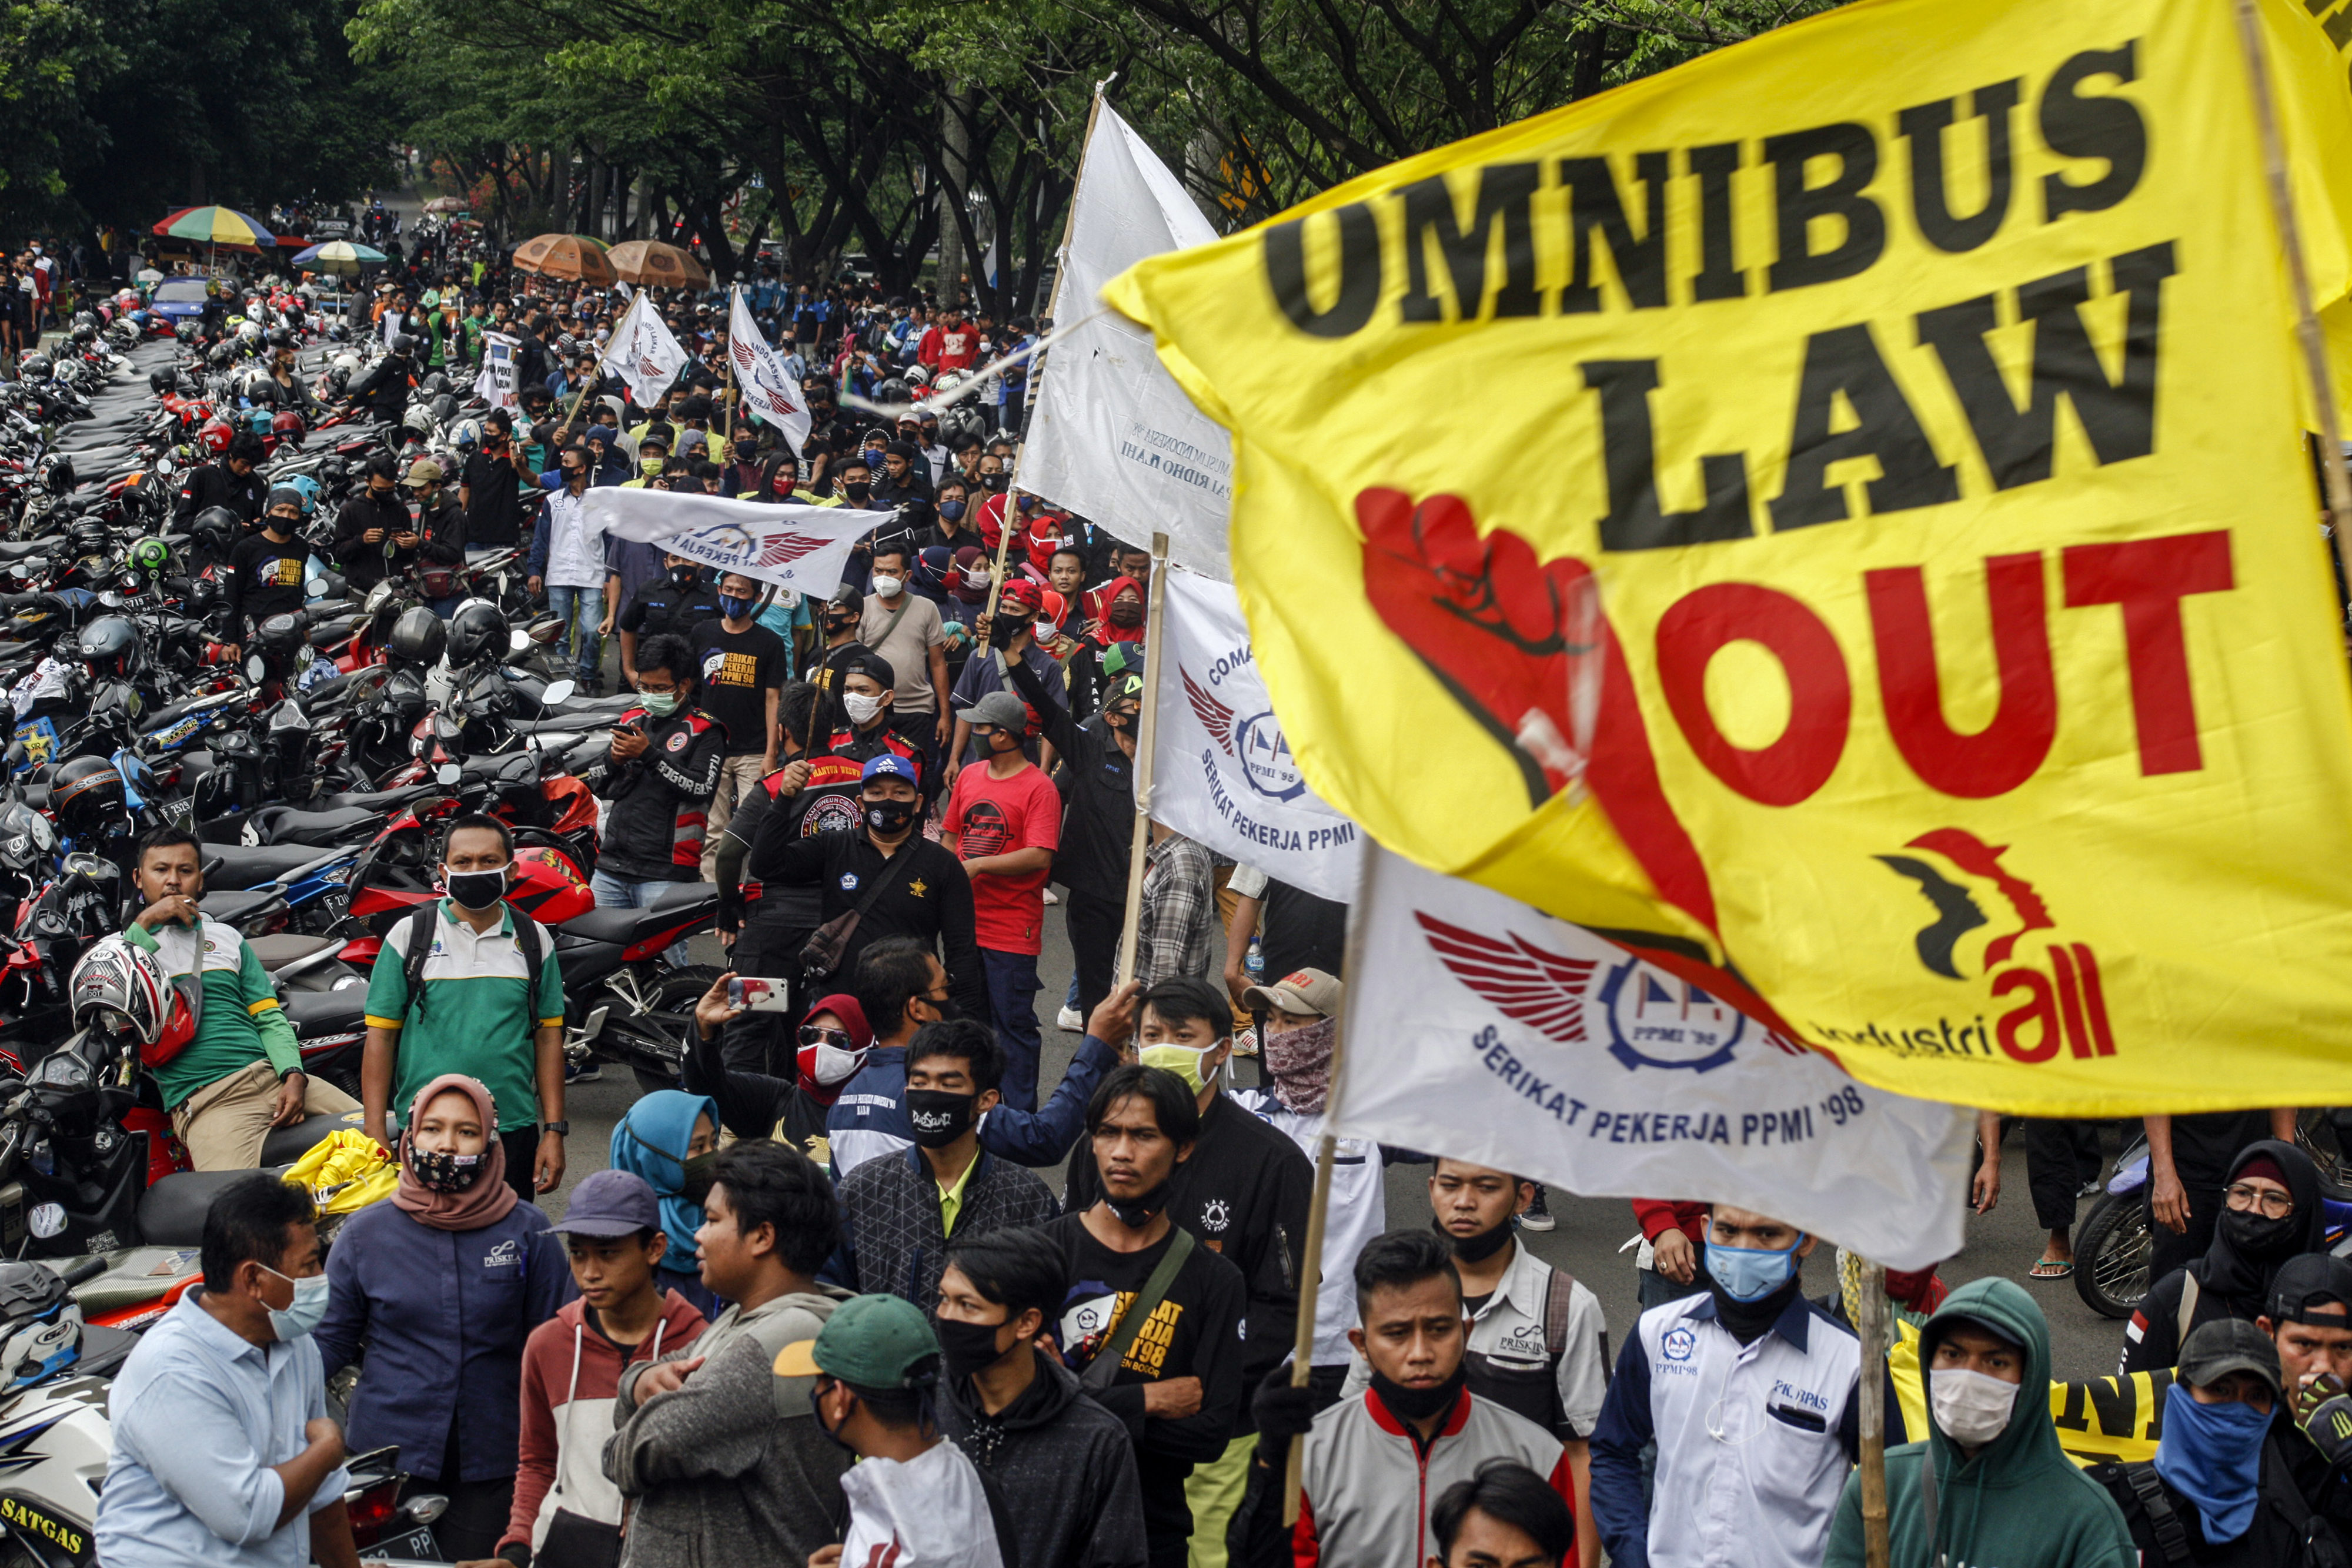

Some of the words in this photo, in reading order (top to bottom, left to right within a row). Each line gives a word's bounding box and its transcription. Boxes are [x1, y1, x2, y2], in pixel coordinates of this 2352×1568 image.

[1262, 39, 2148, 339] OMNIBUS
[767, 358, 783, 390] LASKAR
[1579, 239, 2183, 552] LAW
[722, 662, 756, 676] PEKERJA
[725, 652, 758, 666] SERIKAT
[1655, 529, 2236, 807] OUT
[721, 670, 755, 684] PPMI'98
[898, 735, 916, 747] TRC
[656, 760, 694, 793] BOGOR
[1250, 762, 1275, 778] PPMI
[1202, 748, 1235, 820] SERIKAT
[99, 800, 118, 808] HONDA
[162, 808, 169, 817] F
[170, 801, 191, 814] 2529
[804, 807, 817, 825] TEAM
[839, 798, 860, 823] CIBINONG
[354, 830, 375, 840] HONDA
[1231, 810, 1302, 851] PEKERJA
[1308, 821, 1355, 851] PPMI
[326, 898, 334, 910] F
[1632, 1027, 1685, 1043] PPMI
[1472, 1024, 1587, 1127] SERIKAT
[1589, 1110, 1730, 1145] PEKERJA
[1742, 1106, 1813, 1146] PPMI
[1822, 1084, 1865, 1127] '98
[484, 1253, 522, 1265] PRISKILA
[1, 1498, 82, 1554] SATGAS
[409, 1533, 430, 1557] RP
